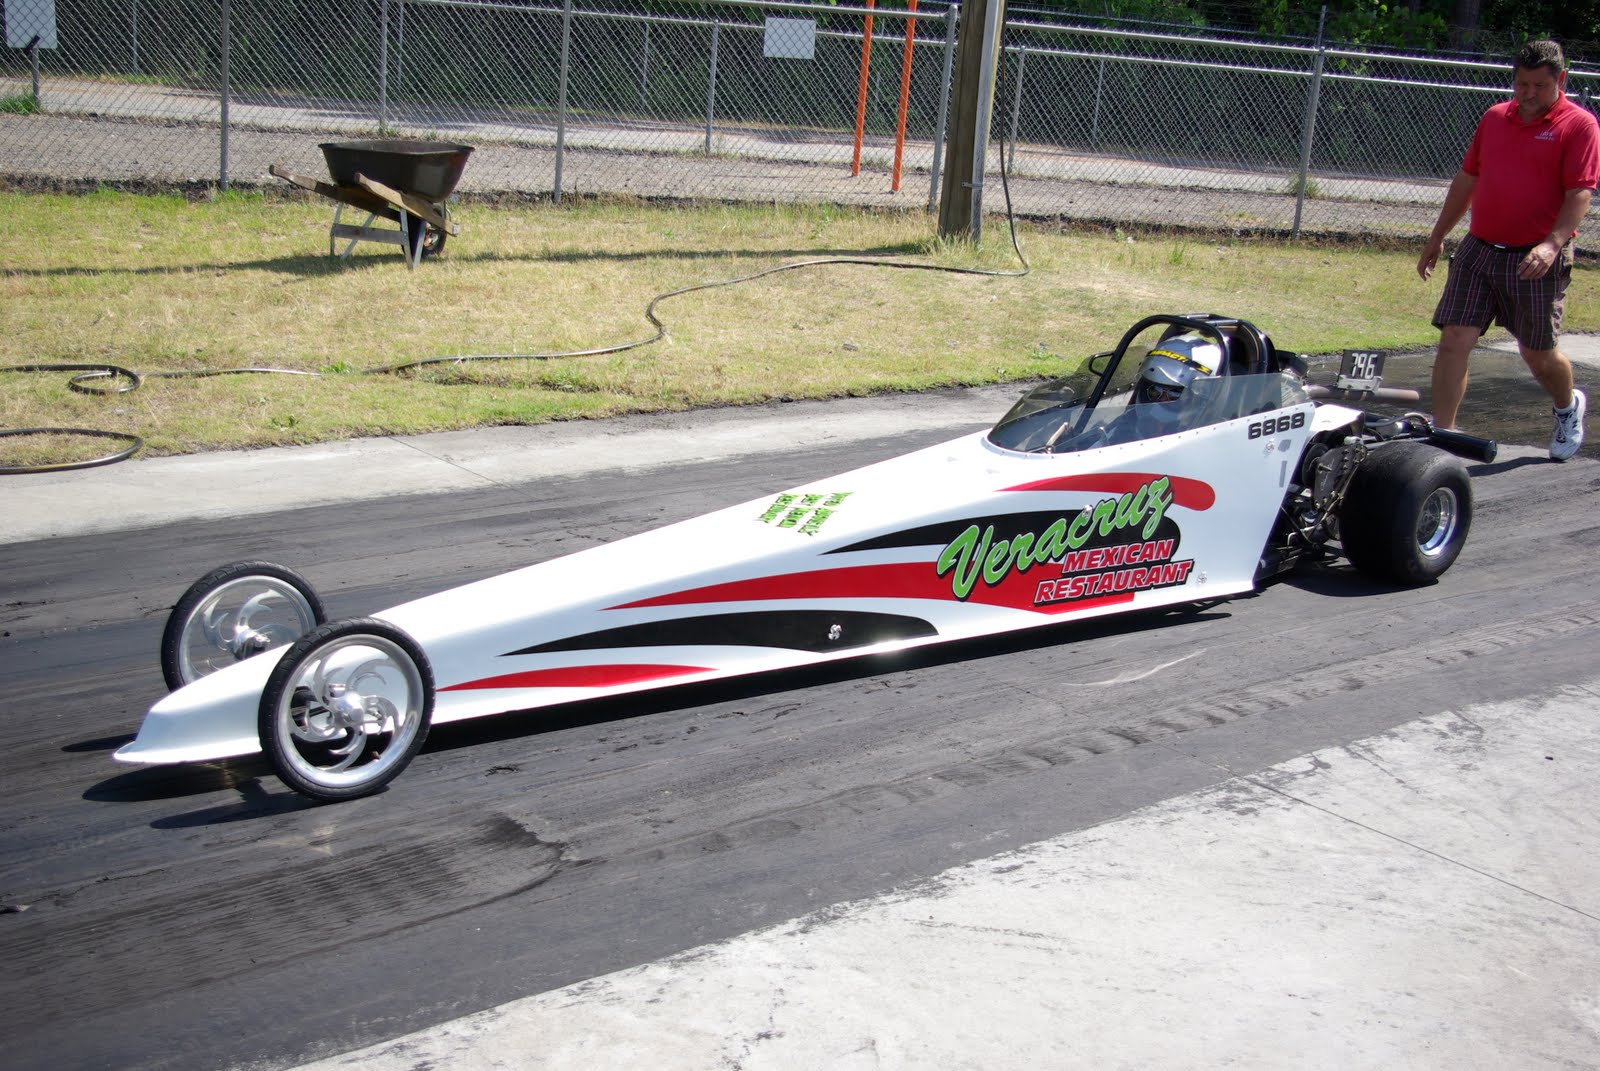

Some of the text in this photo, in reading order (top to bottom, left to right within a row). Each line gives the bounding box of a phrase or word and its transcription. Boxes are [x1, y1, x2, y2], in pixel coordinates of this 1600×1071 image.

[1352, 352, 1378, 379] 796
[1248, 412, 1305, 440] 6868
[936, 475, 1174, 600] Veracruz
[1062, 538, 1175, 574] MEXICAN
[1034, 559, 1194, 604] RESTAURANT
